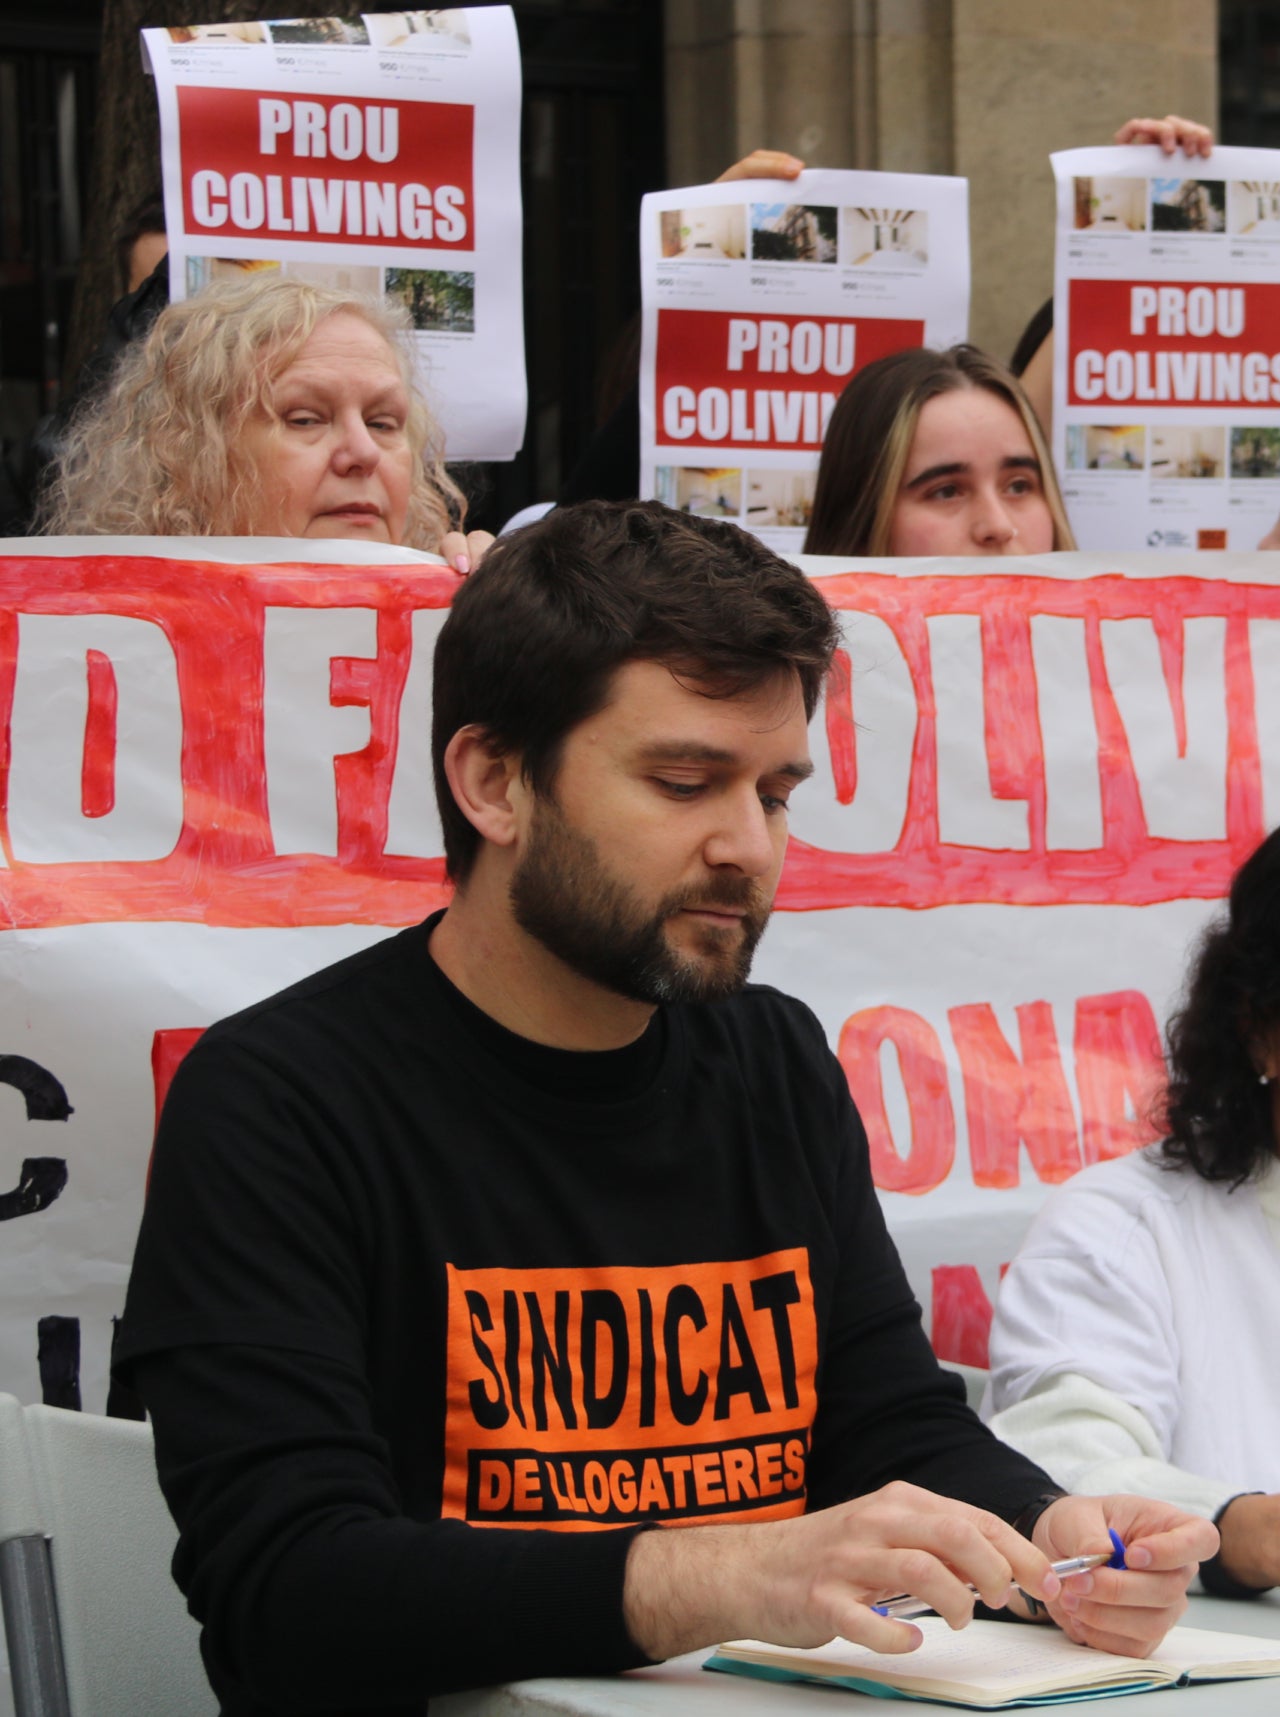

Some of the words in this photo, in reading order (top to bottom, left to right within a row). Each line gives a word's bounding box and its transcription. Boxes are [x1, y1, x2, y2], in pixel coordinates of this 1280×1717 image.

[258, 98, 400, 164] PROU
[191, 169, 467, 243] COLIVINGS
[1130, 286, 1246, 338] PROU
[727, 319, 857, 377] PROU
[662, 386, 840, 444] COLIVI
[464, 1269, 801, 1432] SINDICAT
[478, 1458, 544, 1512] DE
[545, 1438, 806, 1514] LLOGATERES
